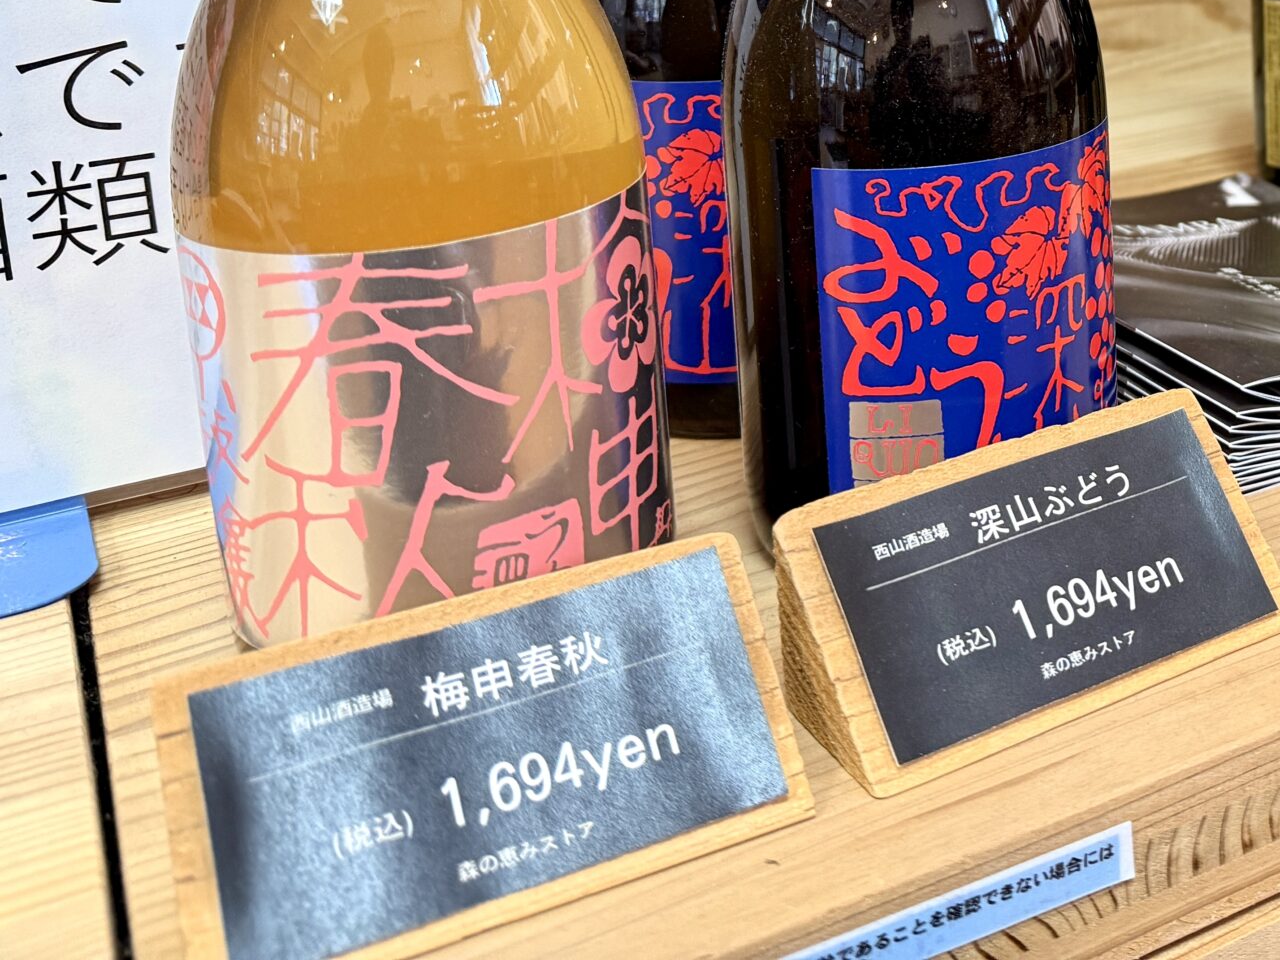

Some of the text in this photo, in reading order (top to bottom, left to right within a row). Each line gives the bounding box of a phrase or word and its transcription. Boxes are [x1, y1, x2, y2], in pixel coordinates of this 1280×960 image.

[16, 41, 144, 130] で
[0, 152, 171, 281] 類
[872, 464, 1132, 561] 西山酒造場 深山ぶどう
[936, 555, 1184, 665] (税込) 1,694yen
[1040, 629, 1137, 680] 森の恵みストア
[420, 630, 609, 718] 梅申春秋
[332, 722, 680, 858] (税込) 1,694yen
[457, 820, 594, 883] 森の恵みストア
